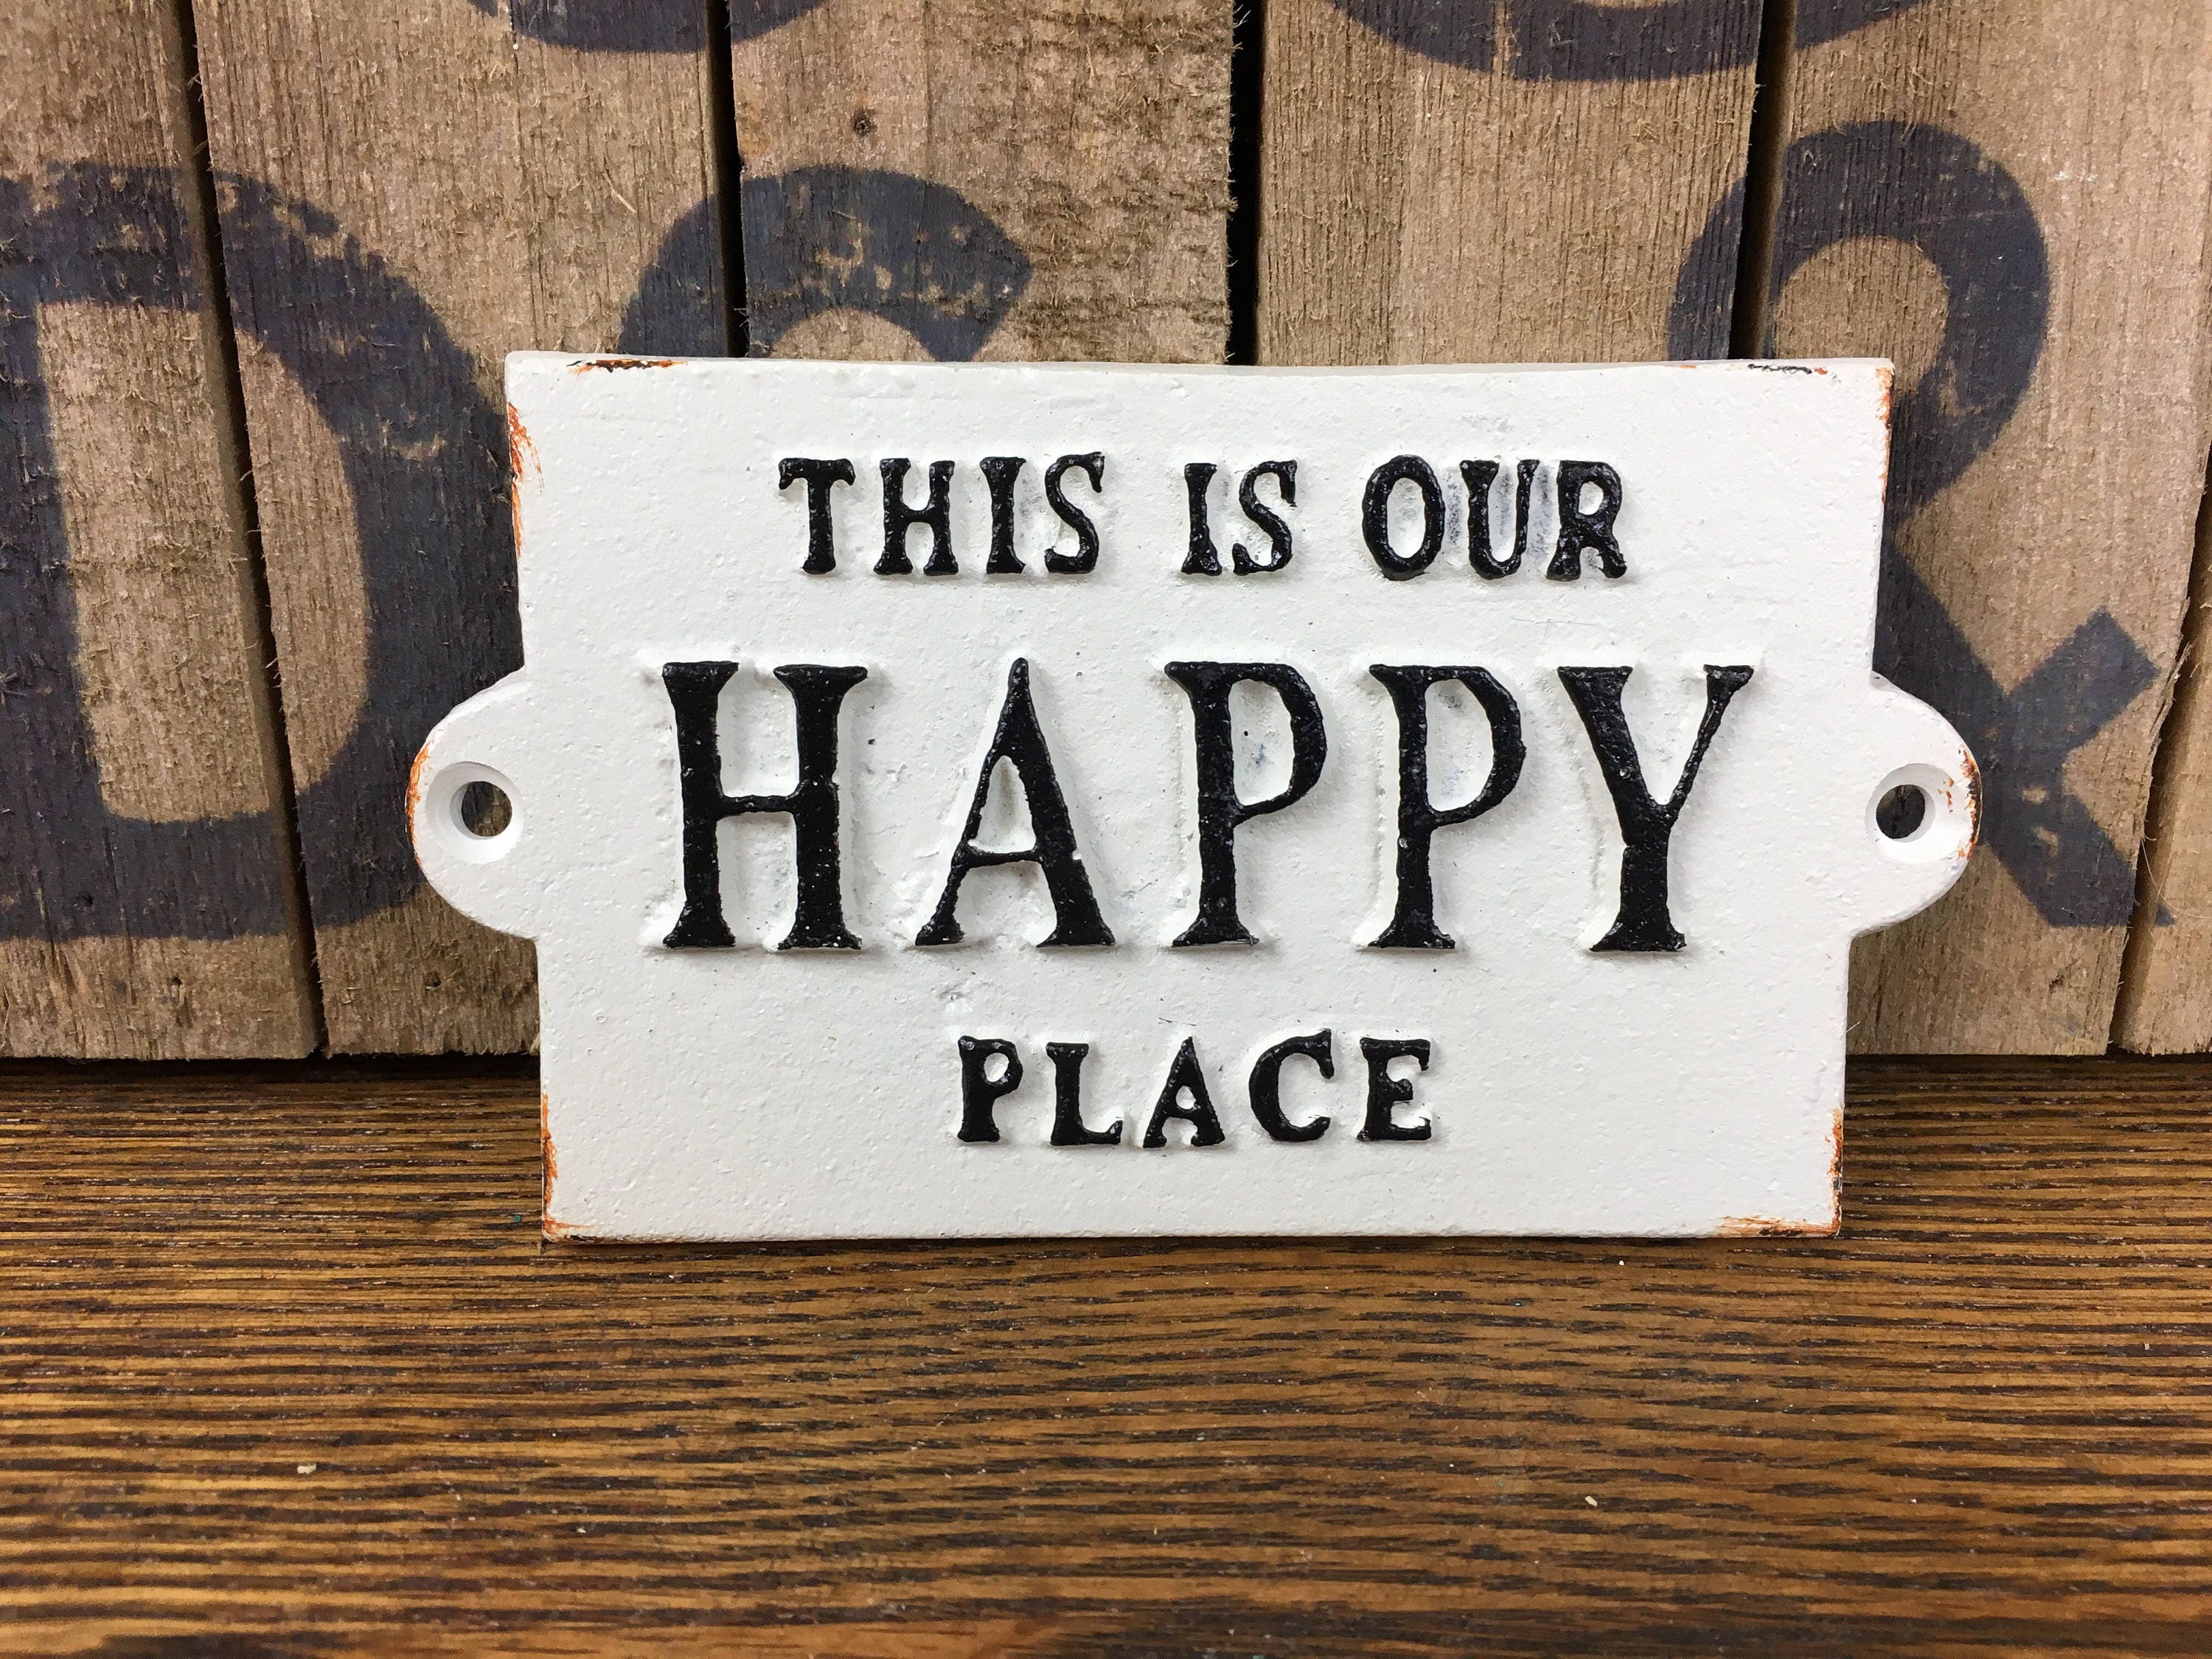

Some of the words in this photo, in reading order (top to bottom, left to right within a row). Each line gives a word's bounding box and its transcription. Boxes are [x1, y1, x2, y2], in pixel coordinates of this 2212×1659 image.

[779, 452, 1105, 576] THIS
[1181, 461, 1297, 576] IS
[1363, 456, 1627, 581] OUR
[662, 658, 1753, 952] HAPPY
[958, 1029, 1431, 1148] PLACE
